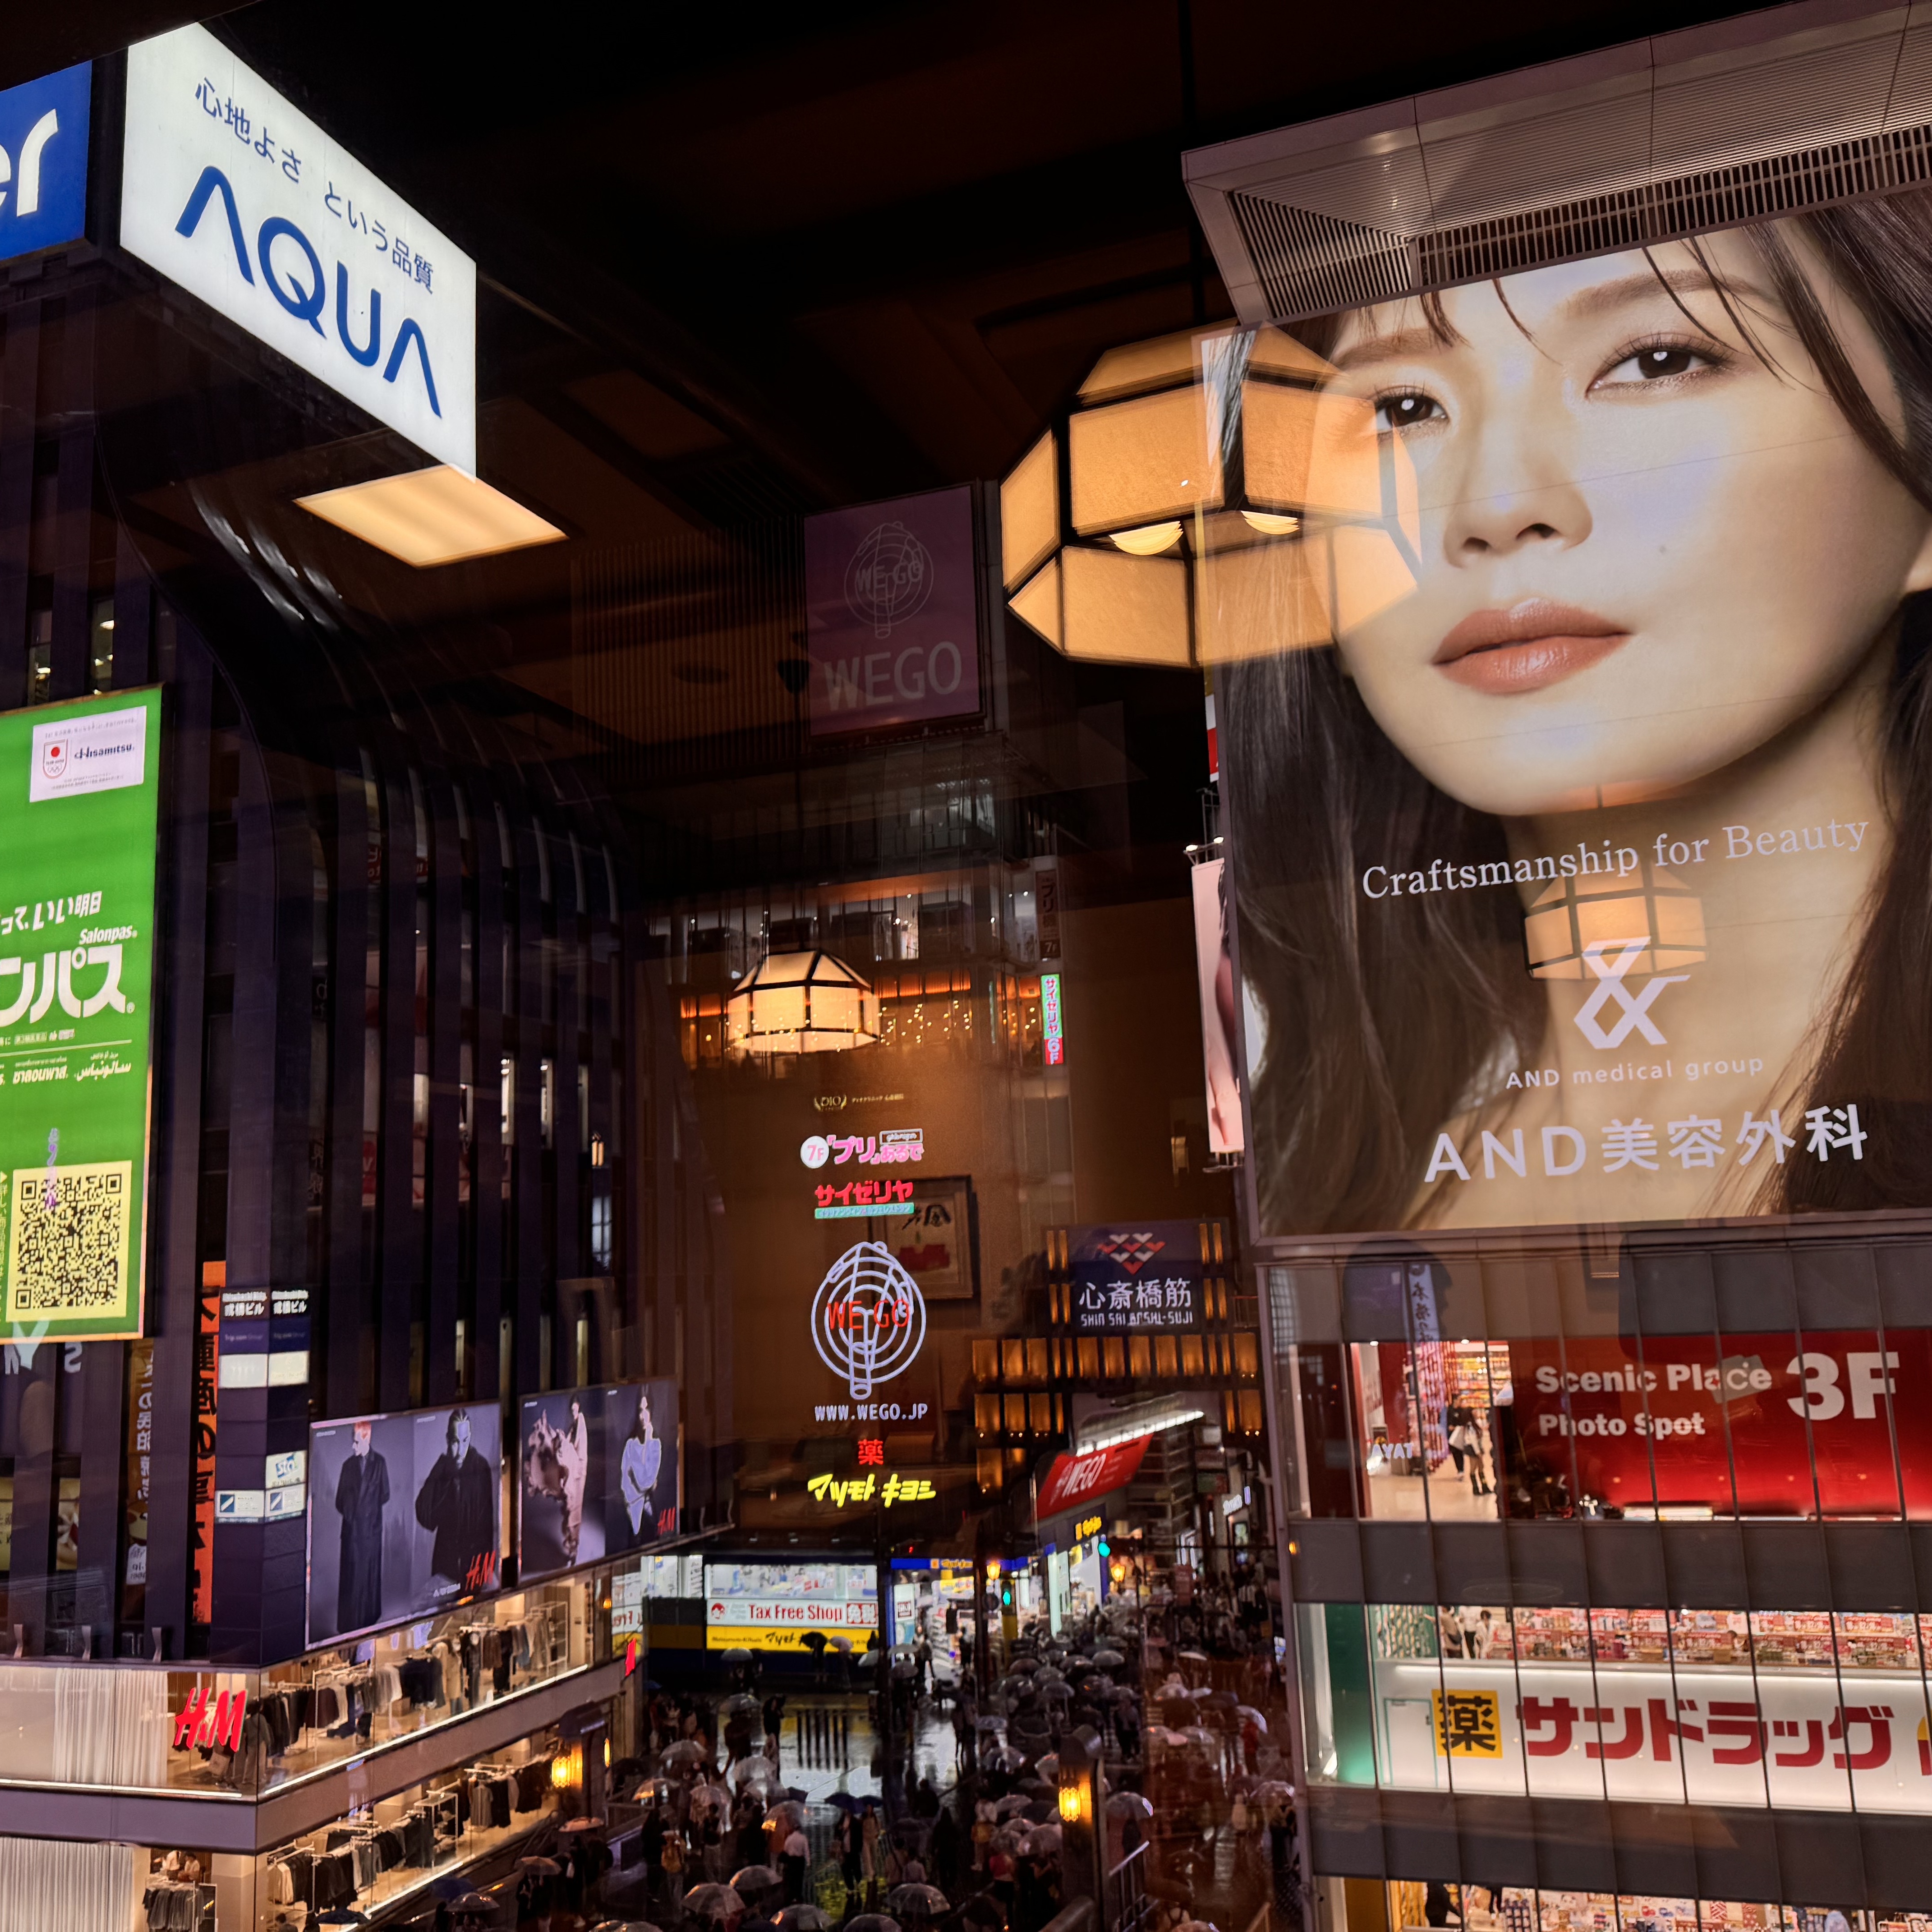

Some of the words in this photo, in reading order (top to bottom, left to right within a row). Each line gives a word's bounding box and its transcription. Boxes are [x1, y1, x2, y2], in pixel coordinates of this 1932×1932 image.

[194, 77, 302, 183] 心地よさ
[323, 180, 433, 295] という品質
[175, 165, 442, 419] AQUA
[823, 641, 962, 712] WEGO
[74, 743, 132, 759] Hisamitsu
[1362, 840, 1640, 899] Craftsmanship
[1652, 833, 1710, 869] for
[1722, 818, 1870, 860] Beauty
[78, 925, 133, 945] Salonpas
[1048, 1038, 1060, 1064] 6F
[1505, 1069, 1561, 1090] AND
[1572, 1060, 1673, 1085] medical
[1685, 1056, 1764, 1081] group
[808, 1145, 824, 1161] 7F
[1424, 1104, 1868, 1183] AND美容外科
[814, 1180, 914, 1207] サイゼリヤ
[1078, 1278, 1191, 1310] 心斎橋筋
[1536, 1364, 1657, 1393] Scenic
[1667, 1363, 1773, 1391] Place
[1786, 1351, 1900, 1421] 3F
[814, 1403, 928, 1421] WWW.WEGO.JP
[1539, 1412, 1628, 1437] Photo
[1633, 1412, 1706, 1441] Spot
[858, 1440, 883, 1465] 薬
[749, 1603, 771, 1620] Tax
[774, 1604, 804, 1620] Free
[807, 1603, 843, 1621] Shop
[174, 1688, 248, 1752] H&M
[1438, 1694, 1496, 1753] 薬
[1515, 1696, 1895, 1770] サンドラッグ
